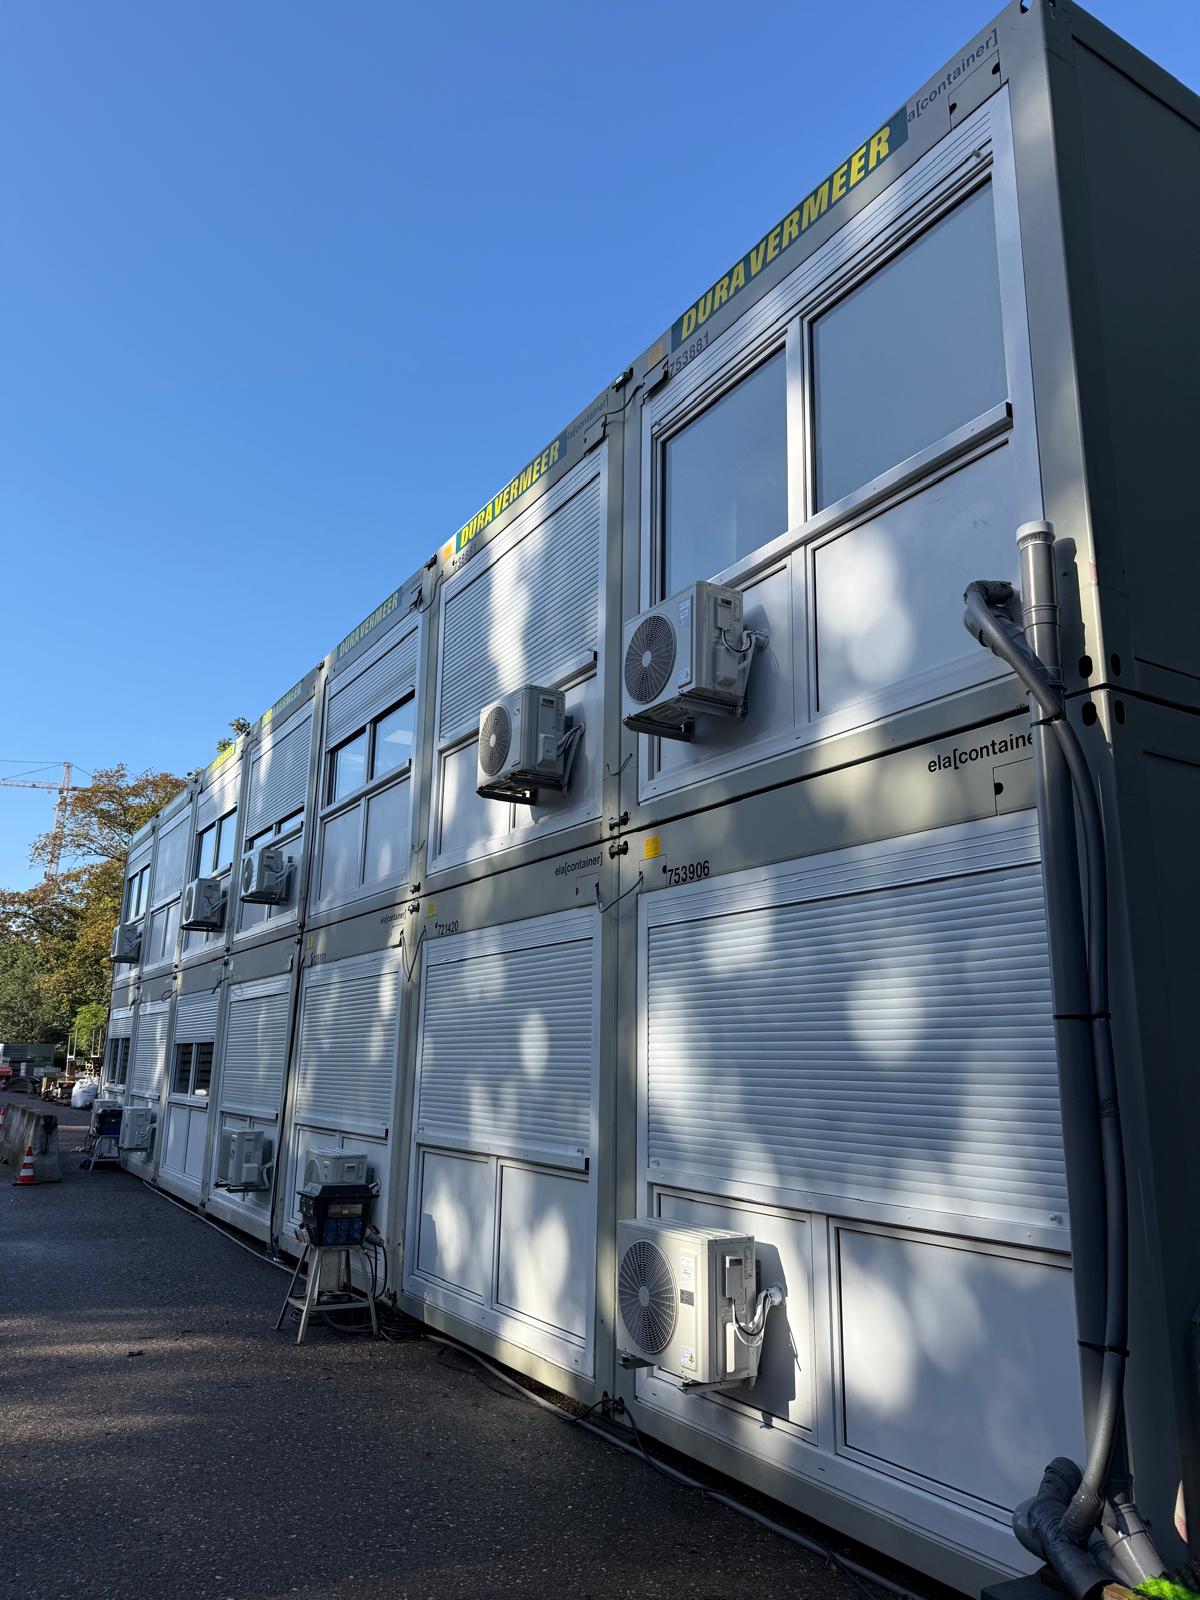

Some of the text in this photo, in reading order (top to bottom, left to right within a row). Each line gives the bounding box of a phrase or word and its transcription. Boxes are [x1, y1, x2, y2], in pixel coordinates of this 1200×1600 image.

[907, 27, 998, 123] a[container]
[681, 126, 891, 342] DURA VERMEER
[669, 330, 709, 377] 753881
[460, 439, 560, 548] DURA VERMEER
[359, 592, 399, 641] VERMEER
[928, 732, 1033, 773] ela[containe
[555, 851, 603, 876] ela[container]
[667, 860, 710, 885] 753906
